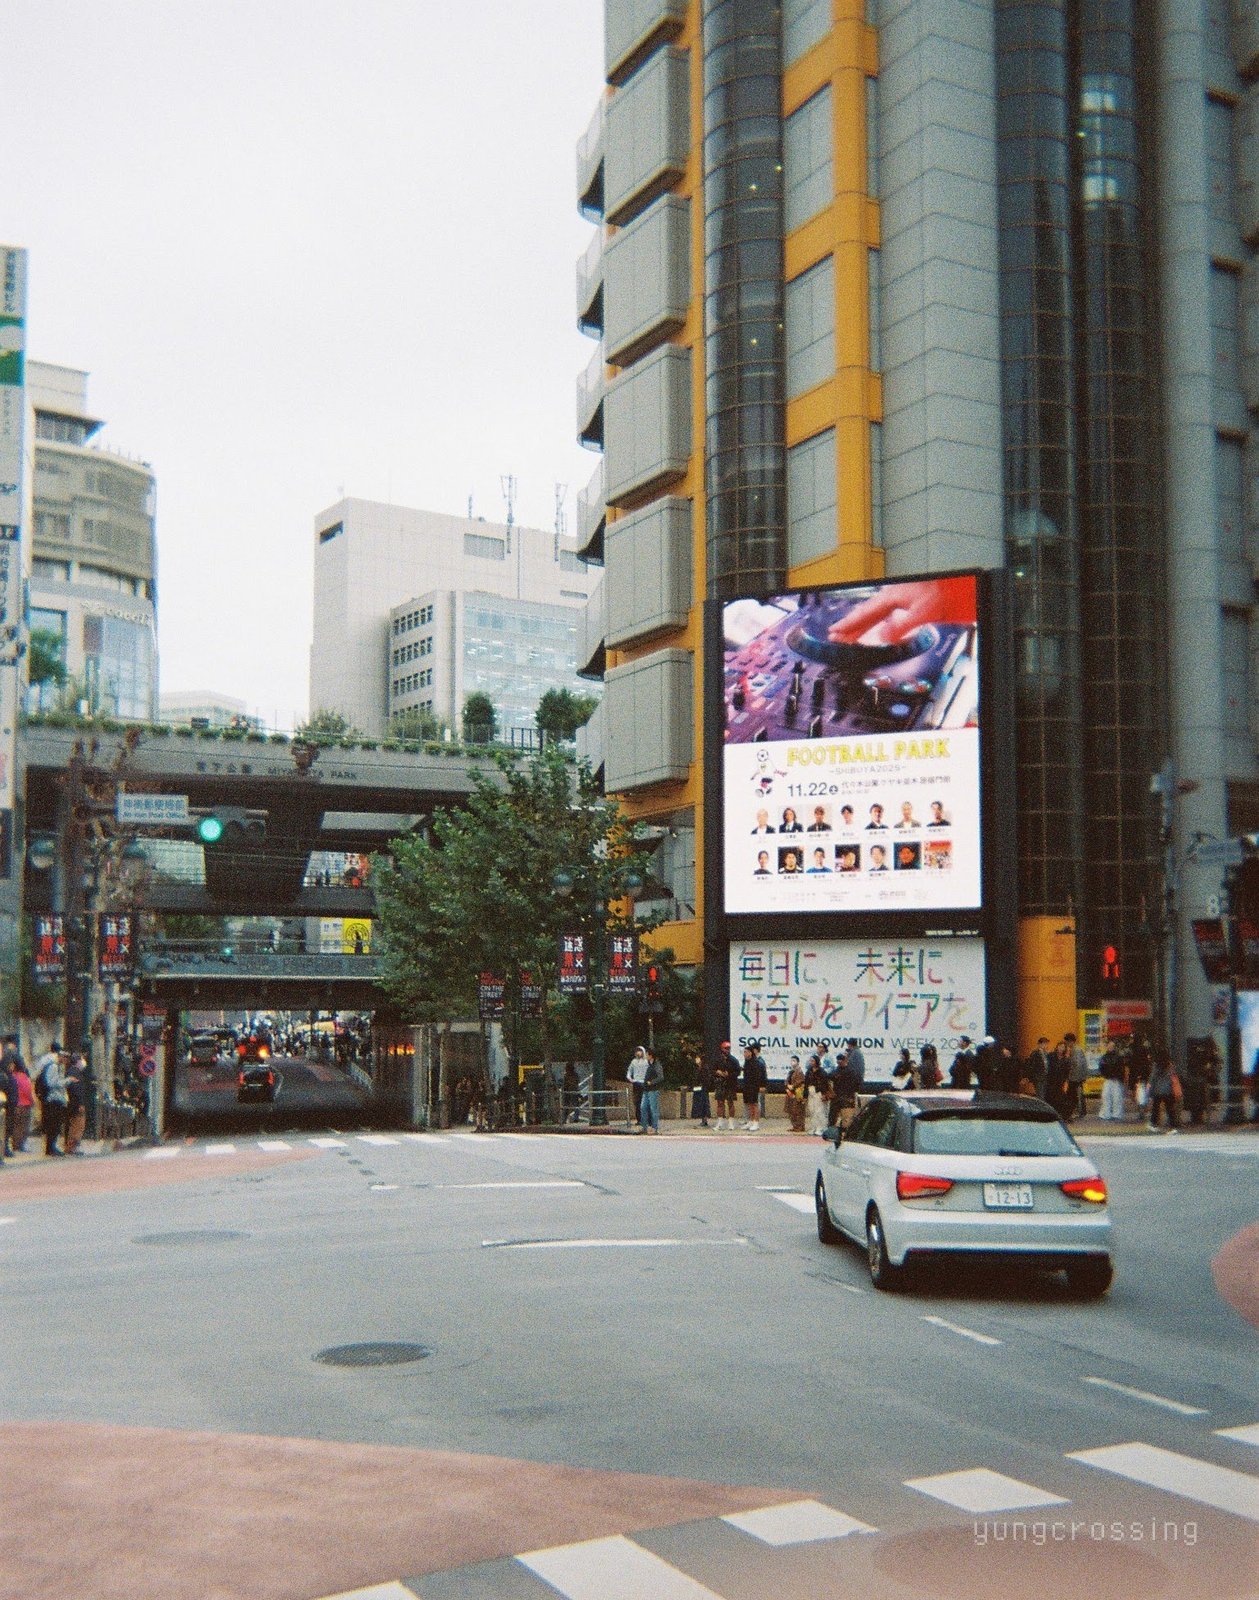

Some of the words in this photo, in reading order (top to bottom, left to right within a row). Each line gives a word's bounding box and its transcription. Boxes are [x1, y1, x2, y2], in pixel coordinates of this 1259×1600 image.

[786, 742, 888, 767] FOOTBALL
[893, 738, 951, 760] PARK
[331, 770, 358, 780] PARK
[788, 783, 827, 797] 11.22
[738, 946, 830, 987] 毎日に、
[853, 946, 956, 987] 未来に、
[738, 1036, 790, 1048] SOCIAL
[795, 1036, 885, 1049] INNOVAION
[890, 1038, 935, 1050] WEEK
[940, 1038, 978, 1050] 205
